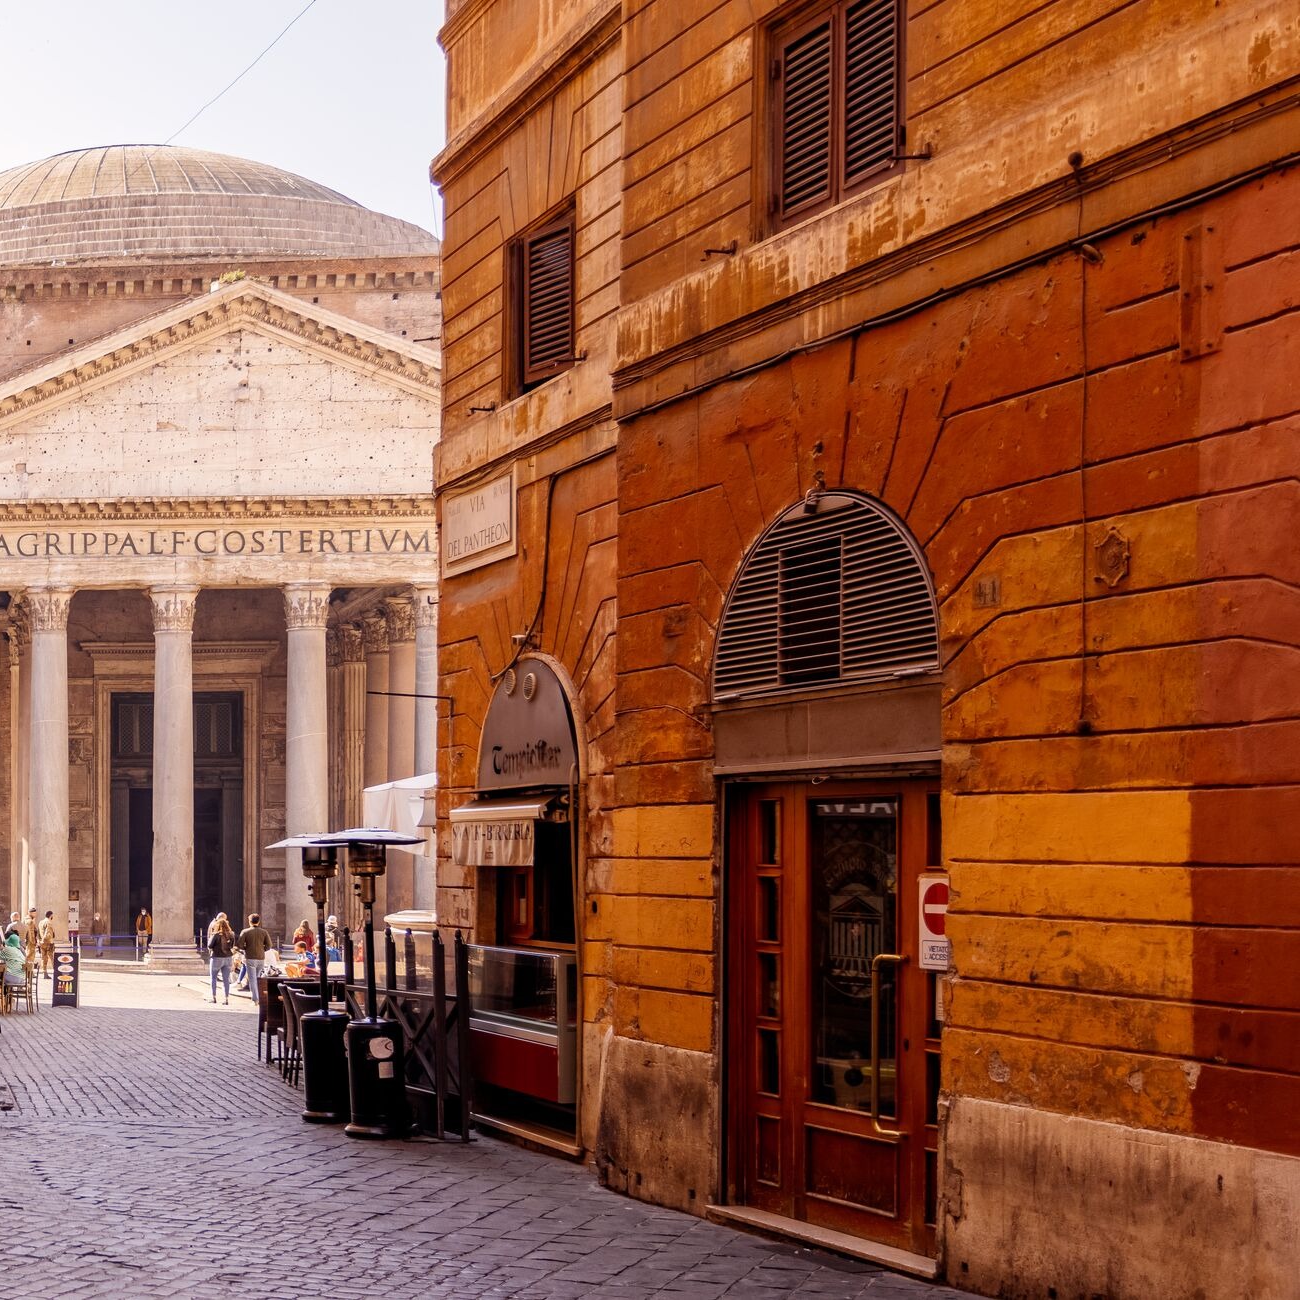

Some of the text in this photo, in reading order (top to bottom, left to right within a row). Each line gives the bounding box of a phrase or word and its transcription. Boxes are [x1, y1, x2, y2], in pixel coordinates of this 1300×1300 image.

[469, 495, 485, 512] VIA
[447, 522, 509, 559] DEL PANTHEON
